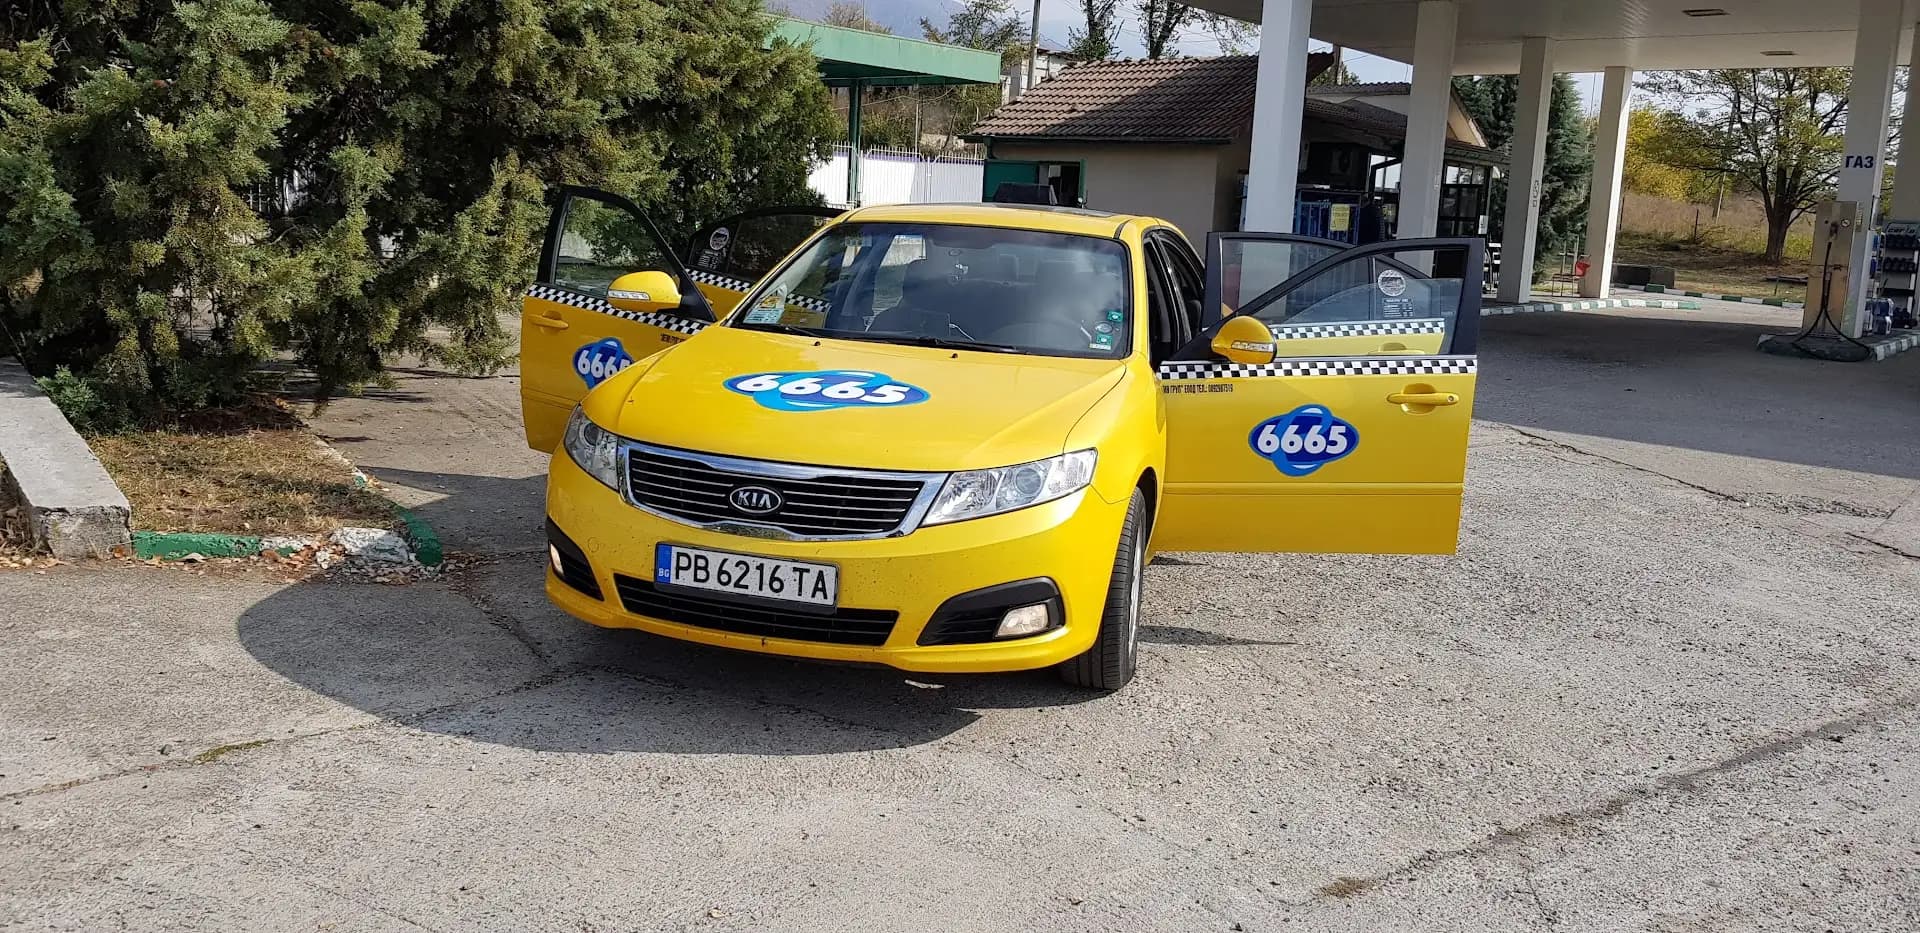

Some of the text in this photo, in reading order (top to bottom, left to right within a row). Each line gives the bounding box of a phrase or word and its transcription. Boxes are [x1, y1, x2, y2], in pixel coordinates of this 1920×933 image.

[1845, 155, 1874, 168] ГАЗ
[736, 374, 911, 404] 6665
[1257, 424, 1348, 455] 6665
[737, 490, 772, 509] KIA
[658, 551, 828, 600] BG PB 6216 TA
